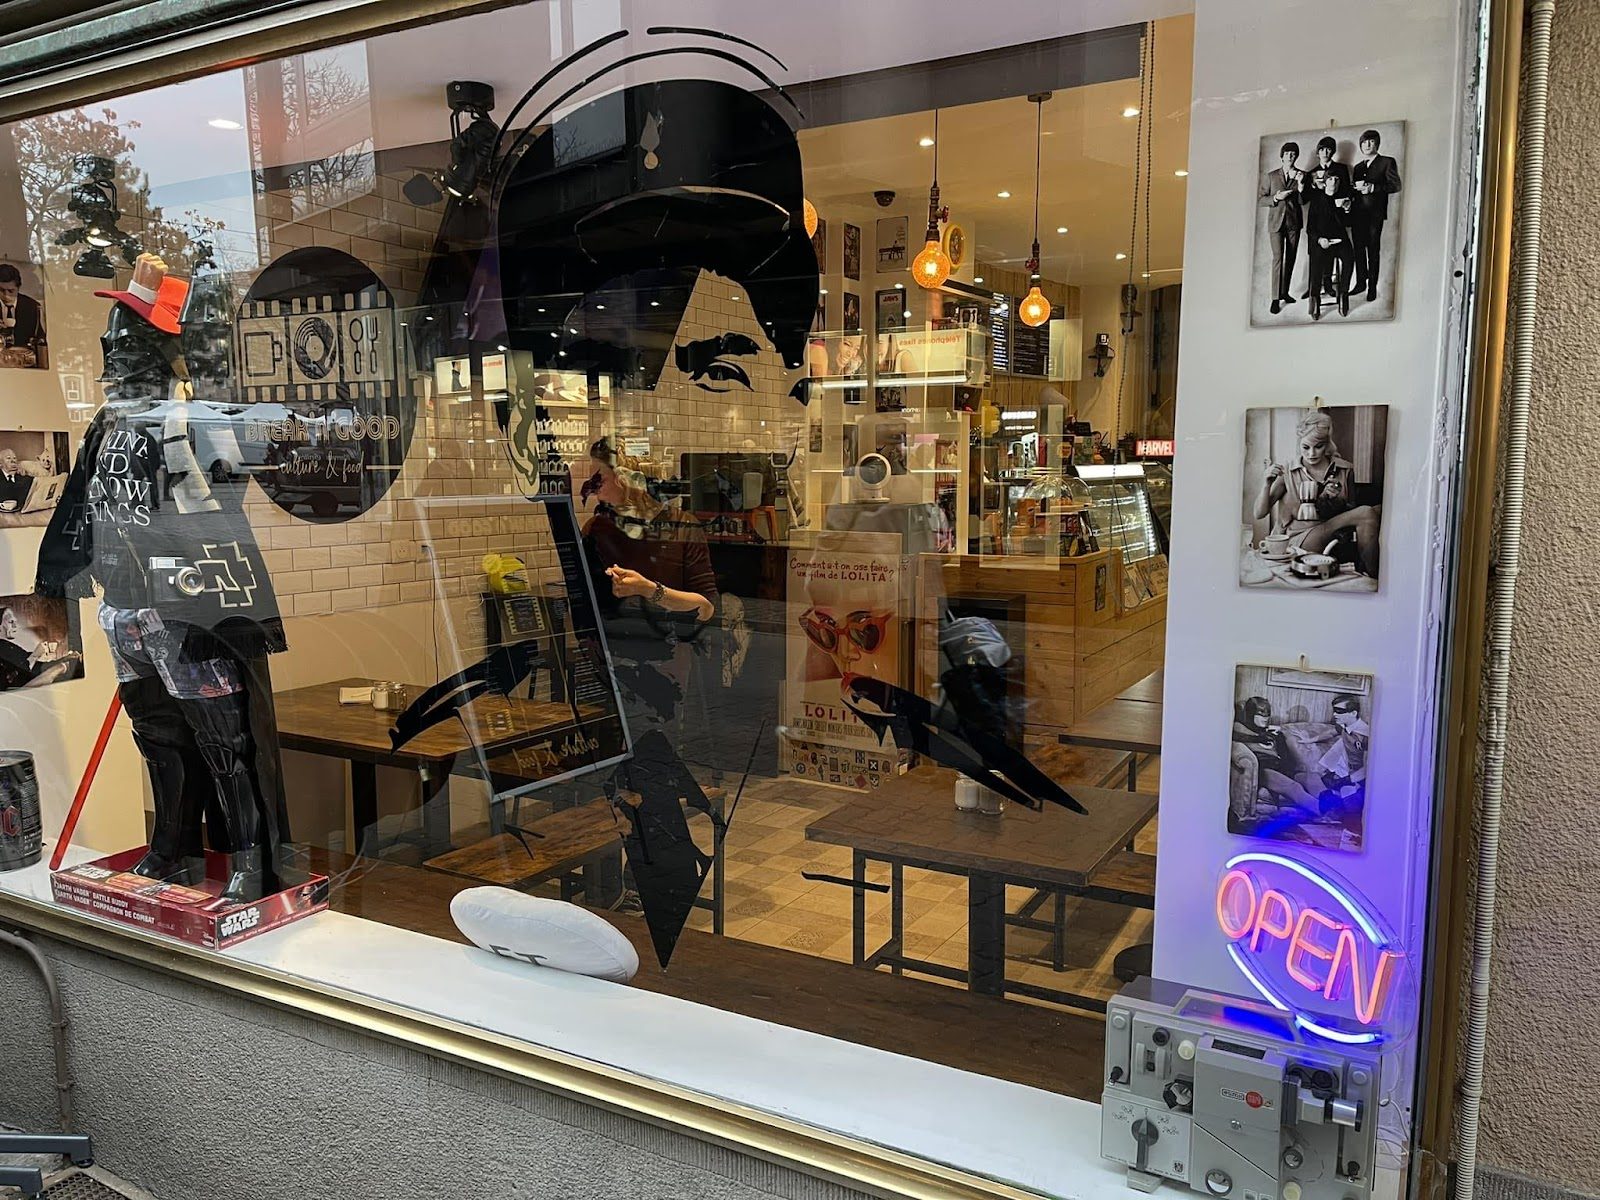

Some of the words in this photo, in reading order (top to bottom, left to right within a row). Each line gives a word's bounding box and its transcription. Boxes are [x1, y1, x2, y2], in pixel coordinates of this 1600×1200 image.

[335, 415, 400, 441] GOOD
[1137, 440, 1174, 455] MARVEL
[342, 451, 364, 482] food
[828, 571, 838, 579] de
[92, 892, 111, 904] BATTLE
[111, 898, 129, 908] BUDDY
[93, 901, 124, 916] COMPAGNON
[124, 909, 132, 918] DE
[132, 912, 155, 924] COMBAT
[223, 906, 260, 928] STAR
[220, 916, 260, 937] WARS
[1217, 869, 1393, 1024] OPEN
